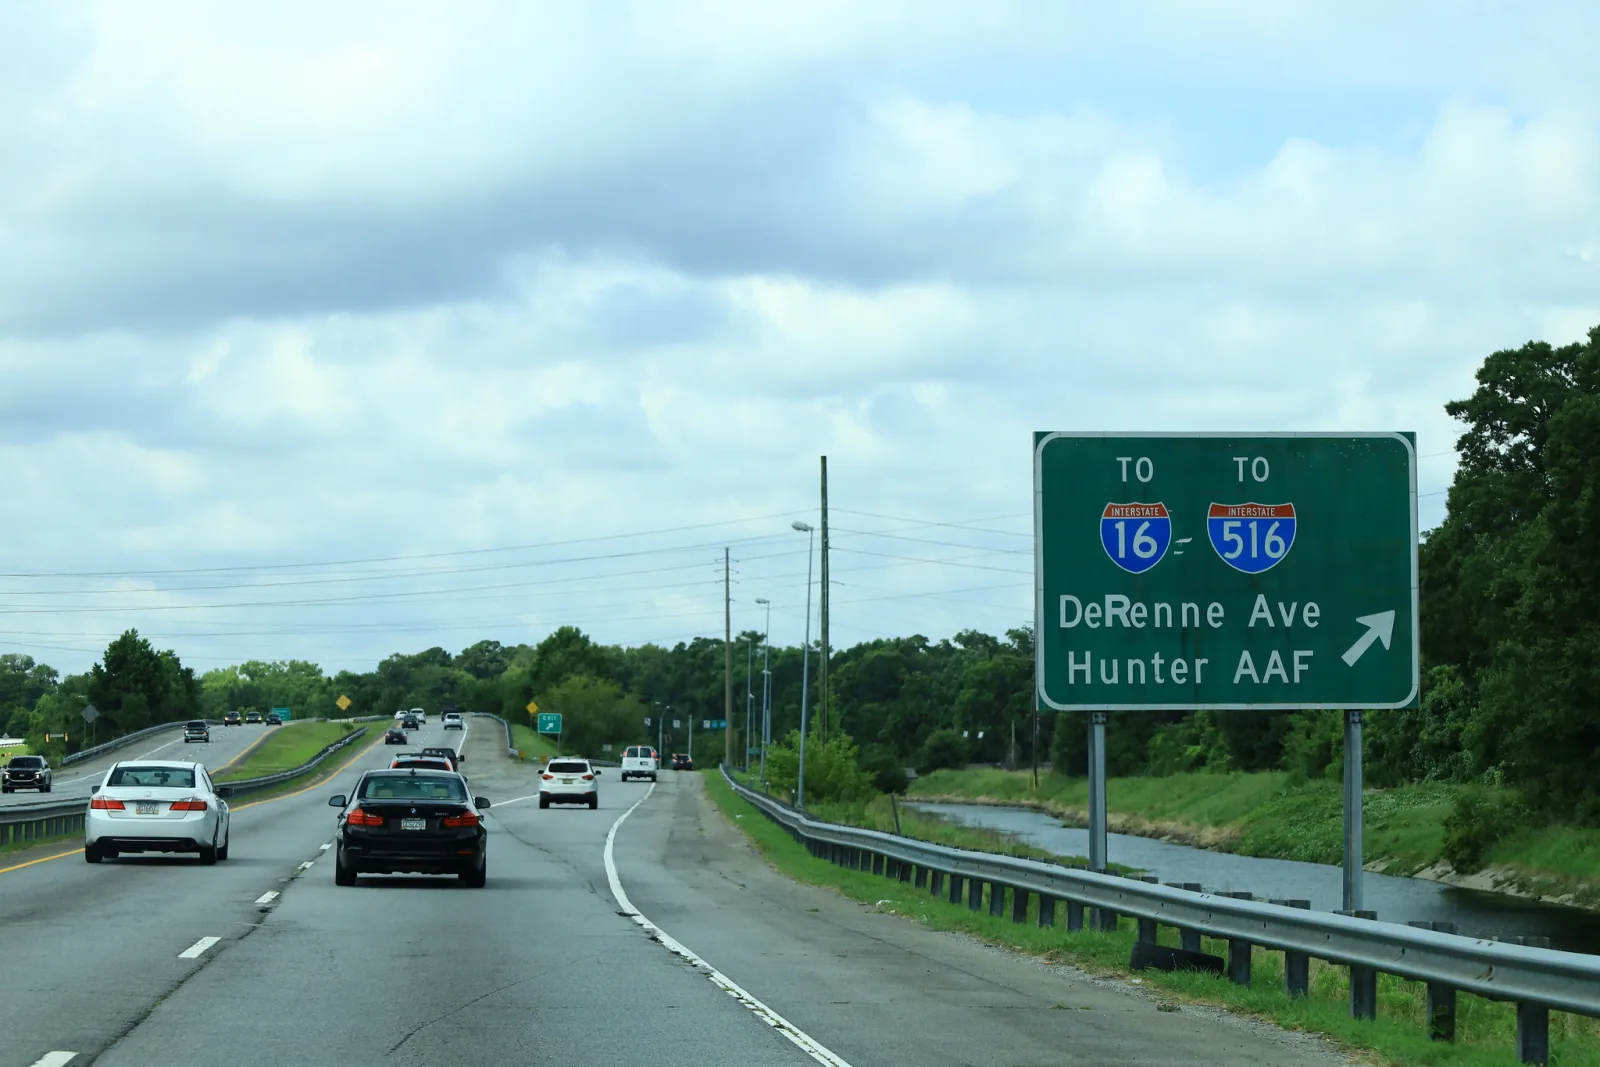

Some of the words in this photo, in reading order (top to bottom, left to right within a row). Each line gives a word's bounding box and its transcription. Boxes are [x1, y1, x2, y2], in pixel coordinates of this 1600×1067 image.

[1116, 457, 1154, 483] TO
[1233, 457, 1270, 483] TO
[1111, 507, 1160, 517] INTERSTATE
[1228, 507, 1276, 517] INTERSTATE
[1115, 521, 1158, 559] 16
[1223, 521, 1286, 559] 516
[1059, 594, 1225, 629] DeRenne
[1248, 594, 1321, 628] Ave
[1068, 650, 1209, 685] Hunter
[1233, 650, 1314, 684] AAF
